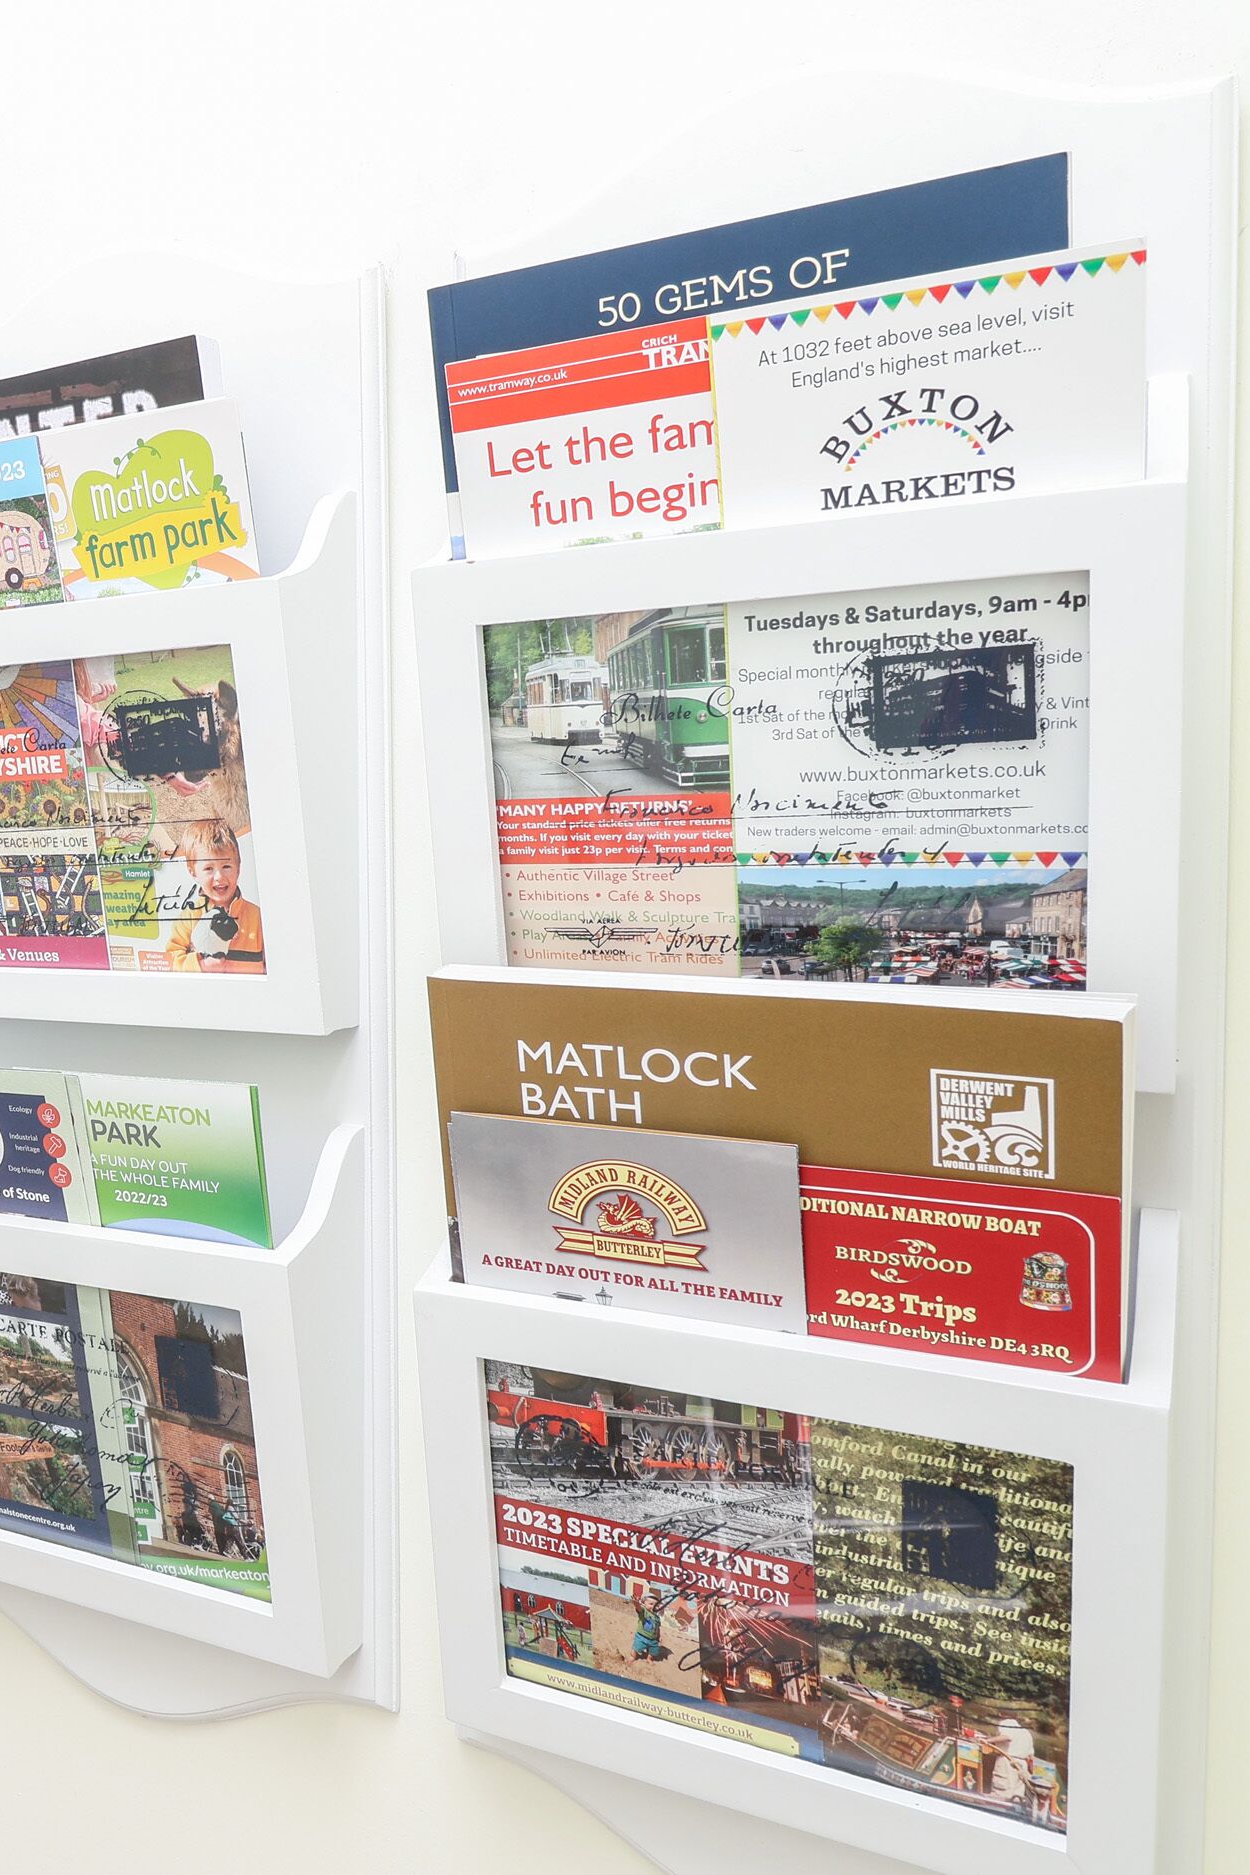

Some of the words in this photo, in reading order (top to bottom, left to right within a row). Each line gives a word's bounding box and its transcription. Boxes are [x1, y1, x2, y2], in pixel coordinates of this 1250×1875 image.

[597, 292, 641, 328] 50
[654, 265, 774, 316] GEMS
[788, 248, 849, 291] OF
[757, 349, 778, 367] At
[782, 342, 831, 364] 1032
[834, 334, 873, 355] feet
[877, 324, 933, 348] above
[457, 368, 567, 397] www.tramway.co.uk
[819, 388, 1014, 464] BUXTON
[90, 458, 200, 522] Matlock
[531, 493, 593, 527] fun
[609, 472, 720, 522] begin
[820, 467, 1015, 511] MARKETS
[86, 533, 156, 578] farm
[164, 497, 237, 564] park
[813, 629, 929, 656] throughout
[936, 629, 974, 646] the
[980, 626, 1027, 647] year
[800, 761, 1047, 786] www.buxtonmarkets.co.uk
[747, 827, 771, 837] New
[775, 825, 816, 837] traders
[819, 824, 871, 837] welcome
[882, 824, 917, 836] email:
[517, 870, 580, 882] Authentic
[584, 870, 628, 882] Village
[632, 870, 674, 881] Street
[519, 891, 590, 901] Exhibitions
[608, 890, 639, 902] Café
[645, 891, 654, 901] &
[659, 890, 701, 903] Shops
[7, 949, 59, 962] Venues
[517, 1039, 758, 1091] MATLOCK
[520, 1081, 642, 1125] BATH
[939, 1078, 1014, 1097] DERWENT
[939, 1091, 993, 1109] VALLEY
[86, 1099, 211, 1126] MARKEATON
[91, 1119, 161, 1148] PARK
[941, 1105, 985, 1122] MILLS
[3, 1187, 16, 1198] of
[16, 1190, 50, 1202] Stone
[114, 1190, 168, 1207] 2022/23
[558, 1167, 619, 1211] MIDLAND
[627, 1169, 695, 1225] RAILWAY
[596, 1239, 662, 1258] BUTTERLEY
[834, 1245, 973, 1275] BIRDSWOOD
[482, 1254, 493, 1266] A
[494, 1256, 542, 1274] GREAT
[546, 1263, 576, 1278] DAY
[578, 1267, 611, 1282] OUT
[614, 1273, 645, 1287] FOR
[648, 1277, 679, 1293] ALL
[681, 1281, 716, 1298] THE
[718, 1287, 783, 1308] FAMILY
[835, 1288, 896, 1314] 2023
[900, 1292, 977, 1327] Trips
[831, 1314, 890, 1335] Wharf
[889, 1322, 987, 1348] Derbyshire
[990, 1337, 1028, 1355] DE4
[1030, 1343, 1074, 1364] 3RQ
[502, 1504, 563, 1536] 2023
[566, 1518, 676, 1560] SPECIAL
[681, 1545, 791, 1585] EVENTS
[503, 1526, 603, 1563] TIMETABLE
[606, 1551, 647, 1572] AND
[650, 1557, 790, 1607] INFORMATION
[834, 1593, 905, 1617] guided
[912, 1609, 965, 1631] trips.
[974, 1621, 1013, 1642] See
[842, 1573, 916, 1597] regular
[923, 1589, 971, 1611] trips
[978, 1604, 1021, 1621] and
[1028, 1612, 1071, 1632] also
[878, 1622, 933, 1646] times
[940, 1639, 982, 1657] and
[987, 1650, 1062, 1676] prices.
[546, 1673, 754, 1741] www.midlandrailway-butterley.co.uk
